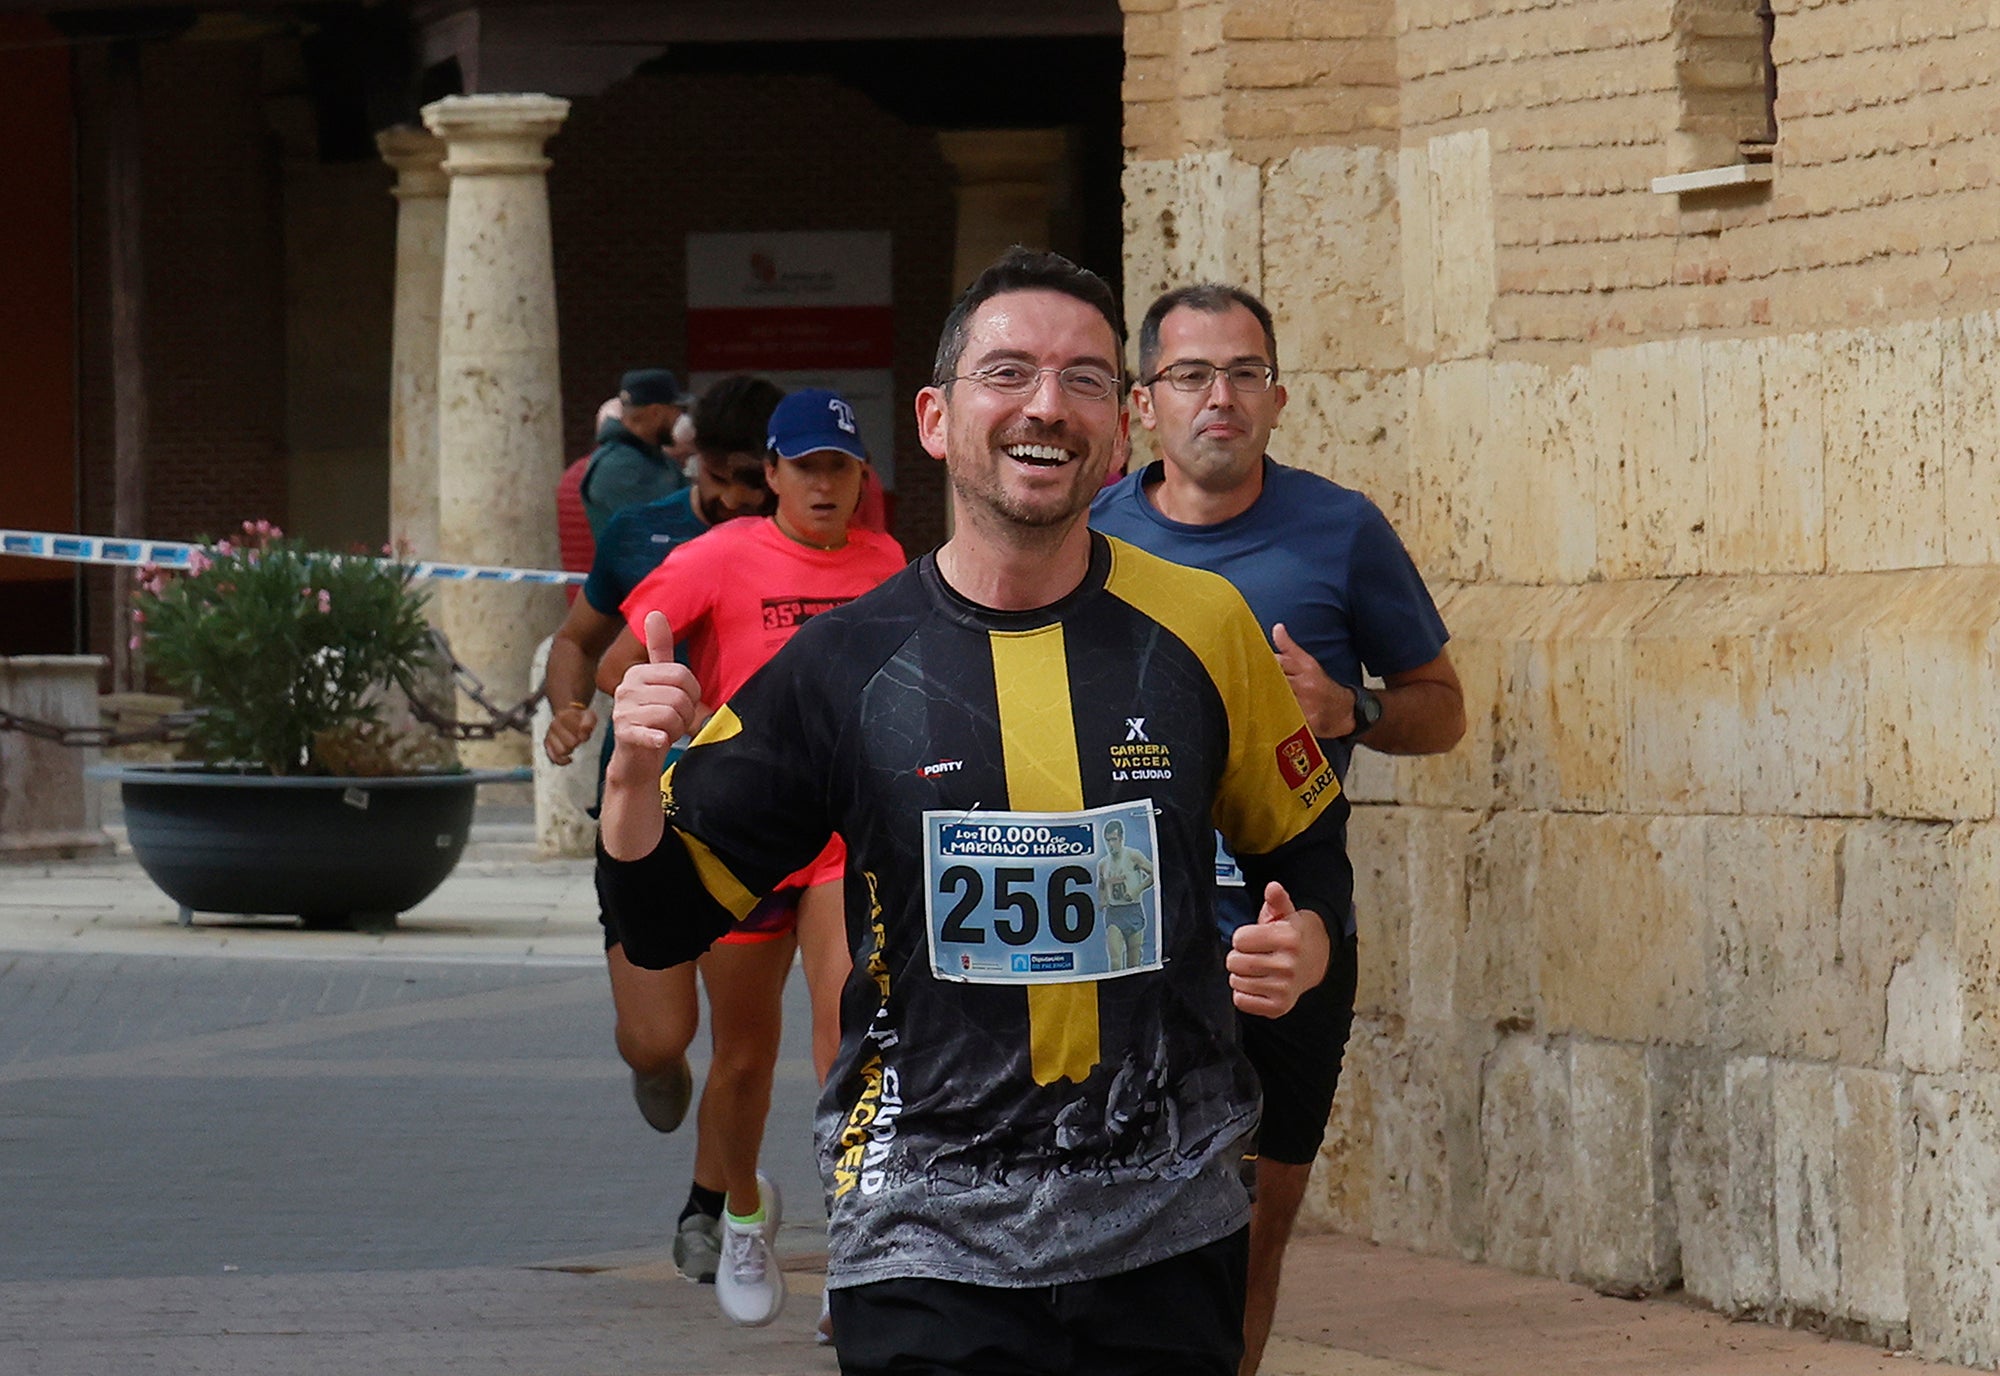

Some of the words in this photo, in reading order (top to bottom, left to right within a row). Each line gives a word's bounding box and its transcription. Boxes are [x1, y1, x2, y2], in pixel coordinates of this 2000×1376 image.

[1110, 744, 1170, 756] CARRERA
[1111, 756, 1171, 768] VACCEA
[1112, 770, 1129, 781] LA
[1131, 769, 1172, 780] CIUDAD
[956, 829, 978, 839] Los
[978, 826, 1051, 843] 10.000
[1050, 835, 1066, 844] de
[950, 841, 1029, 855] MARIANO
[1033, 841, 1084, 855] HARO
[939, 864, 1095, 946] 256
